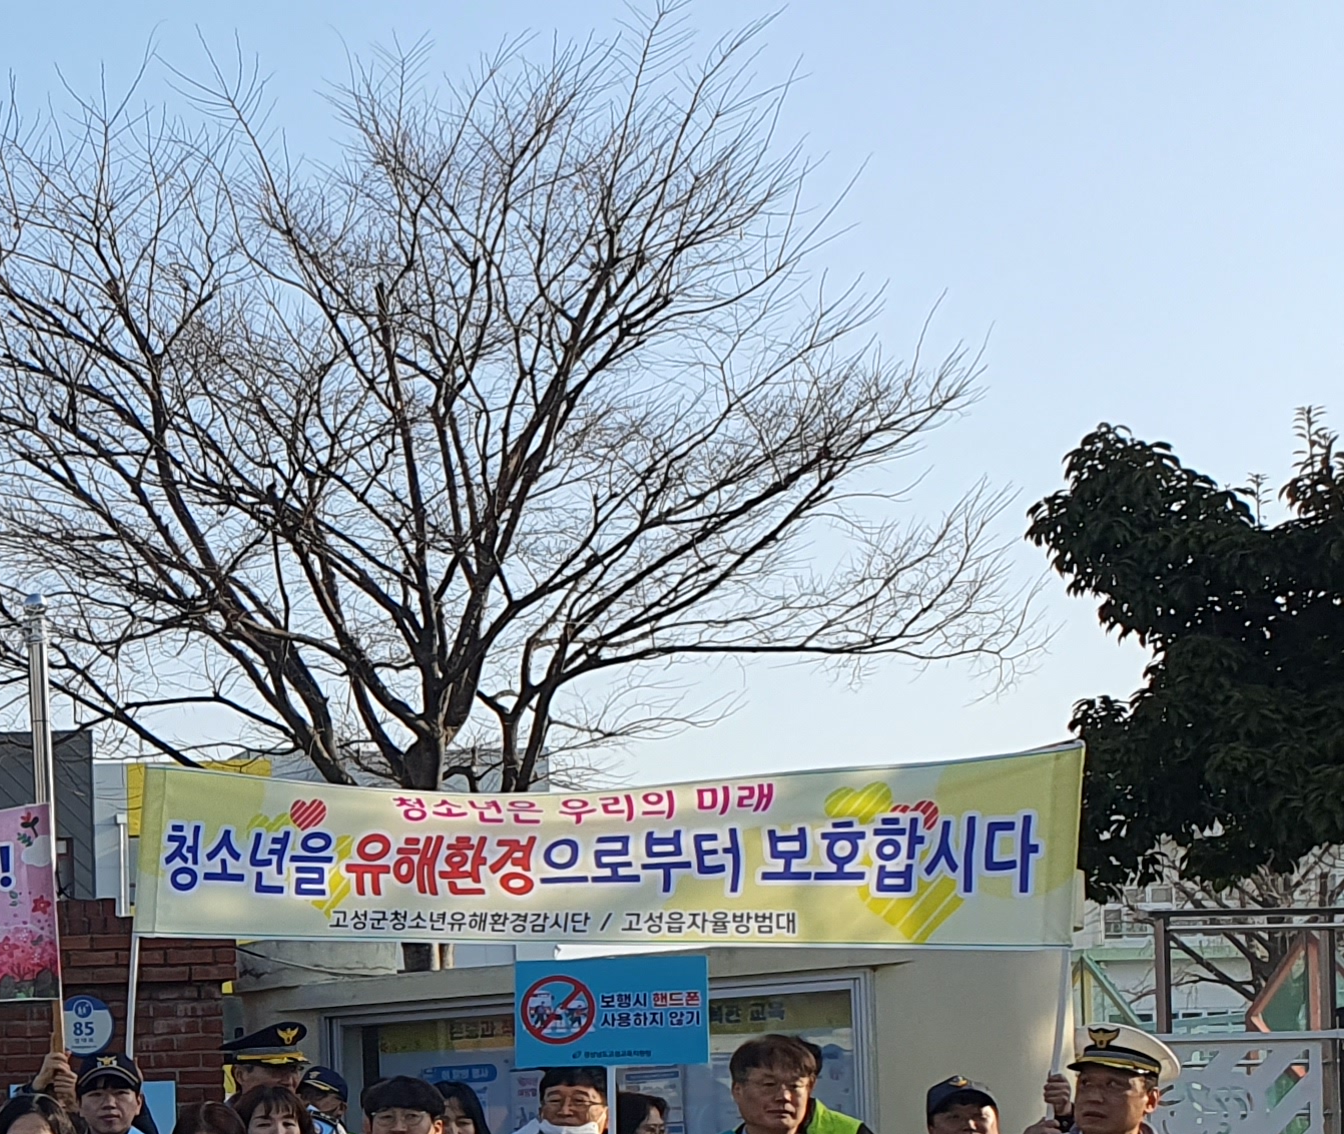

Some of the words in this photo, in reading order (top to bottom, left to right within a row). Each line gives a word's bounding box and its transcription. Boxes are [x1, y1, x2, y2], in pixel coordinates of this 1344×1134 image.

[393, 796, 544, 825] 청소년은
[558, 790, 675, 826] 우리의
[697, 783, 774, 815] 미래
[164, 823, 334, 896] 청소년을
[344, 827, 742, 897] 유해환경으로부터
[760, 813, 1039, 893] 보호합시다
[329, 910, 592, 934] 고성군청소년유해환경감시단
[620, 911, 797, 935] 고성읍자율방범대
[599, 992, 648, 1010] 보행시
[652, 991, 702, 1008] 핸드폰
[73, 1021, 95, 1037] 85
[600, 1011, 664, 1028] 사용하지
[668, 1010, 702, 1027] 않기
